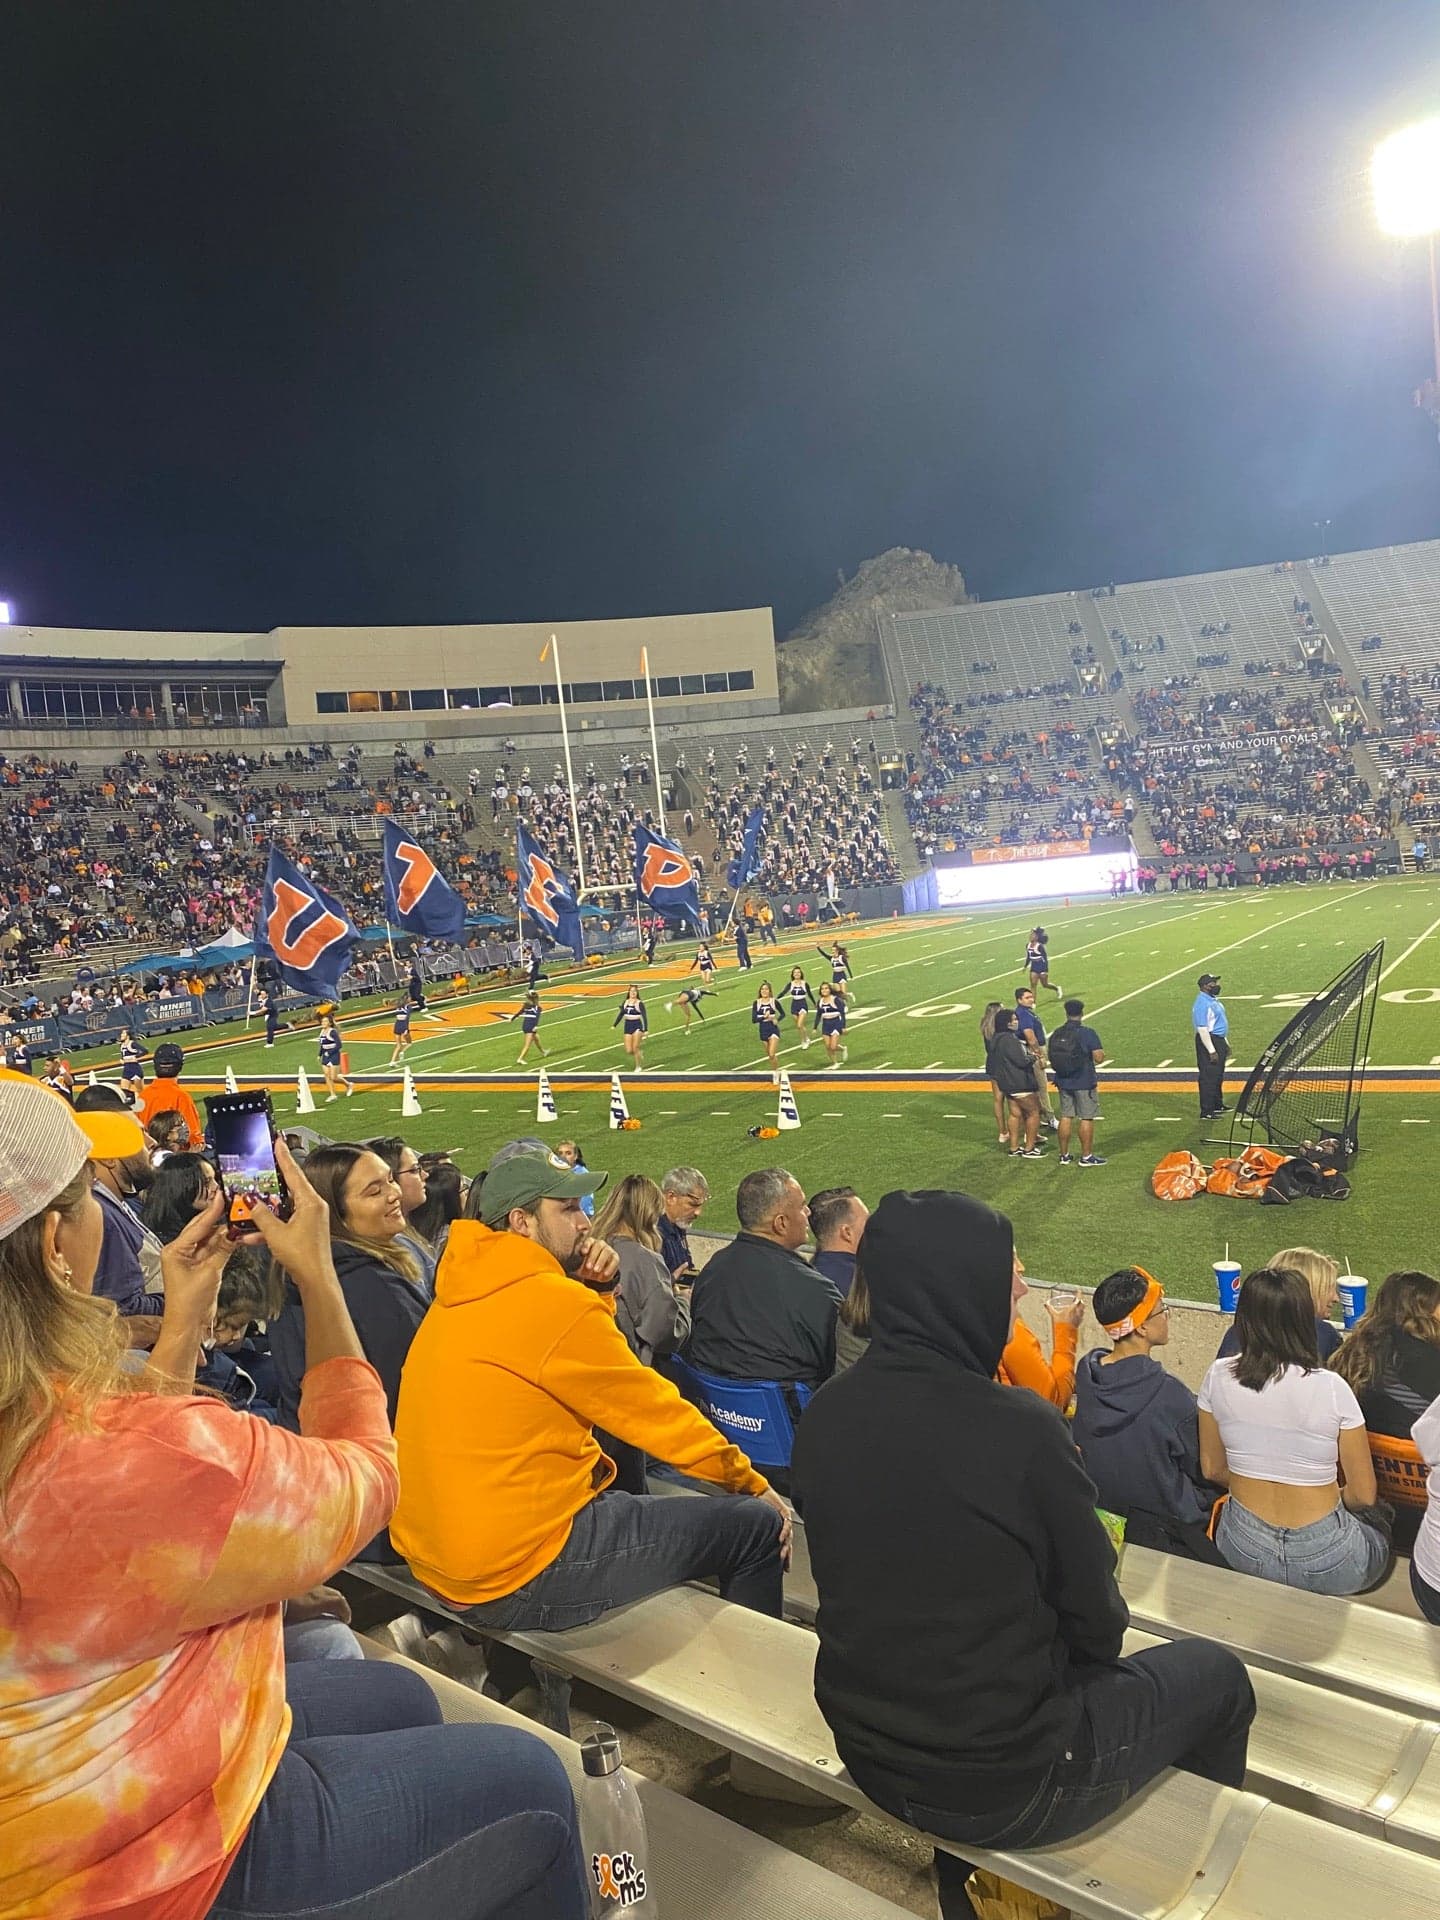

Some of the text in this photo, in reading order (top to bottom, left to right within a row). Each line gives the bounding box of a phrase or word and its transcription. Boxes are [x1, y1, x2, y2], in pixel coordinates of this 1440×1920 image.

[1220, 739, 1244, 750] AND
[1246, 736, 1278, 748] YOUR
[1280, 732, 1319, 744] GOALS
[640, 842, 693, 898] P
[267, 877, 348, 970] U
[160, 1001, 191, 1011] MINER
[541, 1078, 557, 1114] UTEP
[611, 1082, 627, 1121] UTEP
[780, 1080, 798, 1121] UTEP
[710, 1403, 762, 1432] Academy
[620, 1871, 646, 1906] ms
